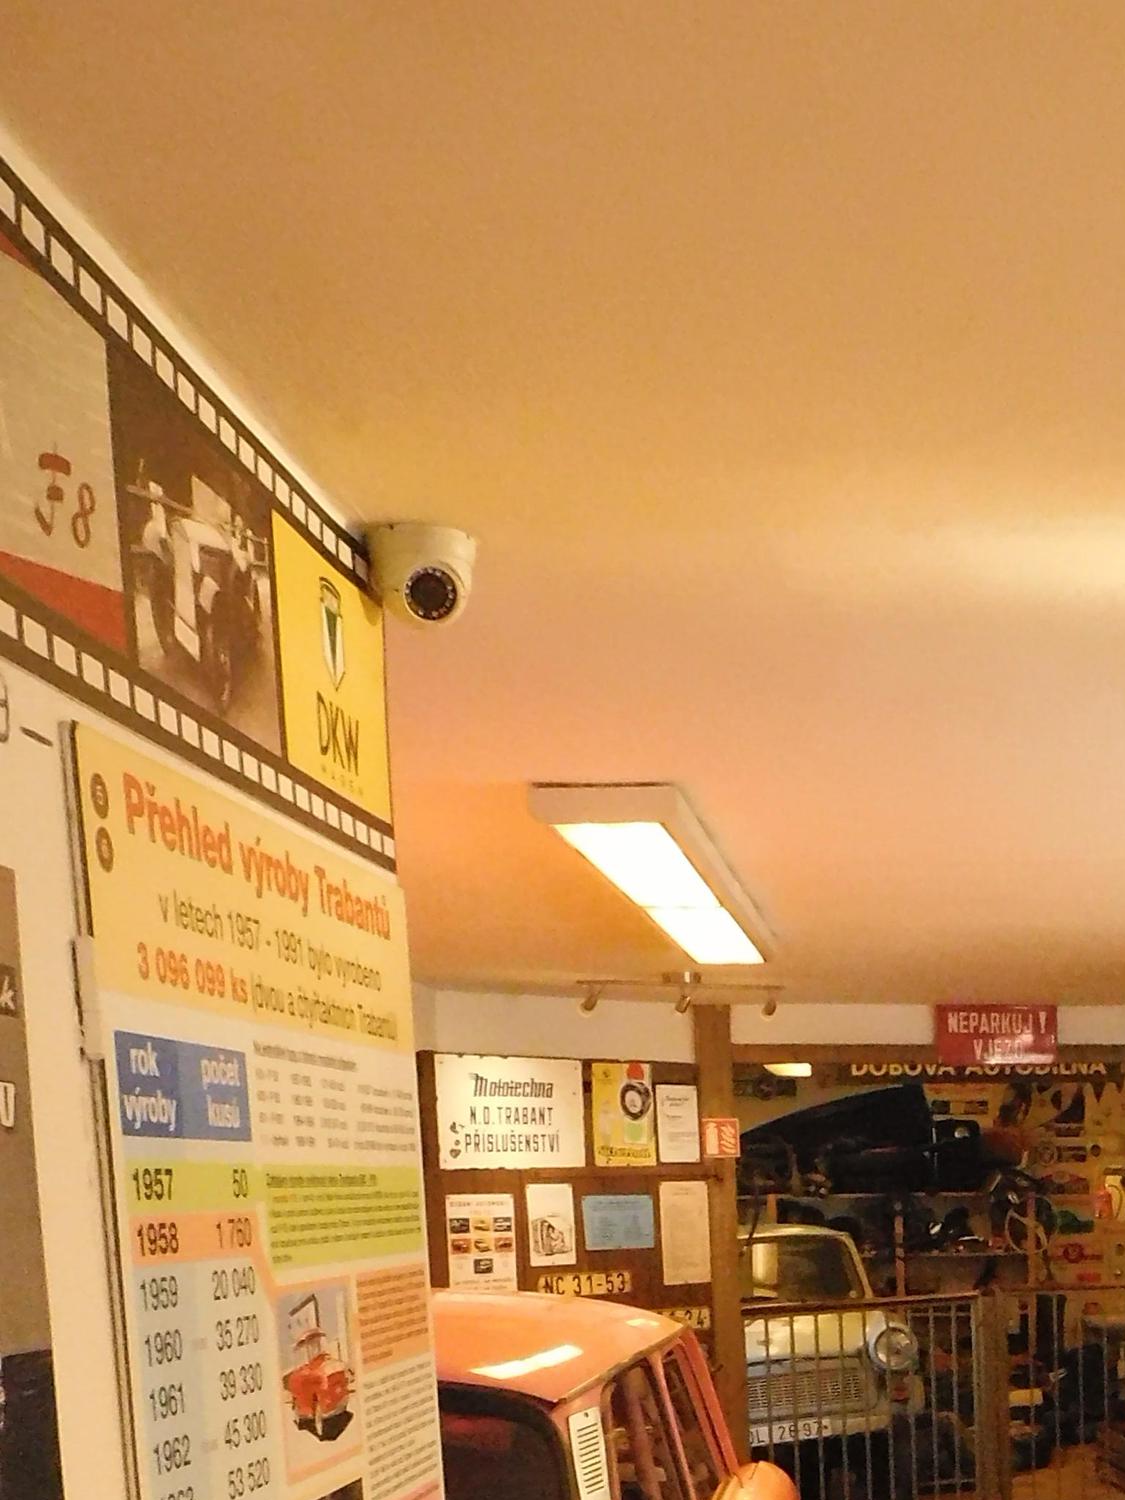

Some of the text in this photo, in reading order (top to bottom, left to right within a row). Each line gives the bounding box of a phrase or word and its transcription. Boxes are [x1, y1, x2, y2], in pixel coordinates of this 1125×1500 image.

[316, 690, 359, 777] DKW
[122, 772, 391, 941] Přehled výroby Trabantů
[158, 893, 169, 924] v
[173, 888, 224, 941] letech
[227, 911, 261, 951] 1957
[274, 927, 304, 967] 1991
[137, 941, 150, 981] 3
[155, 946, 190, 990] 096
[195, 957, 226, 999] 099
[229, 966, 248, 1004] ks
[947, 1011, 1034, 1035] NEPARKUJ
[129, 1042, 160, 1077] rok
[200, 1055, 241, 1091] počet
[469, 1073, 555, 1099] Mototechna
[123, 1085, 177, 1132] výroby
[132, 1167, 174, 1201] 1957
[232, 1168, 248, 1199] 50
[136, 1221, 180, 1257] 1958
[215, 1221, 224, 1249] 1
[227, 1217, 252, 1248] 760
[139, 1265, 256, 1312] 1959 20 040
[543, 1272, 627, 1296] NC 31-53
[144, 1313, 260, 1368] 1960 35 270
[149, 1361, 263, 1422] 1961 39 330
[153, 1409, 267, 1476] 1962 45 300
[227, 1466, 245, 1500] 53
[247, 1456, 271, 1493] 520
